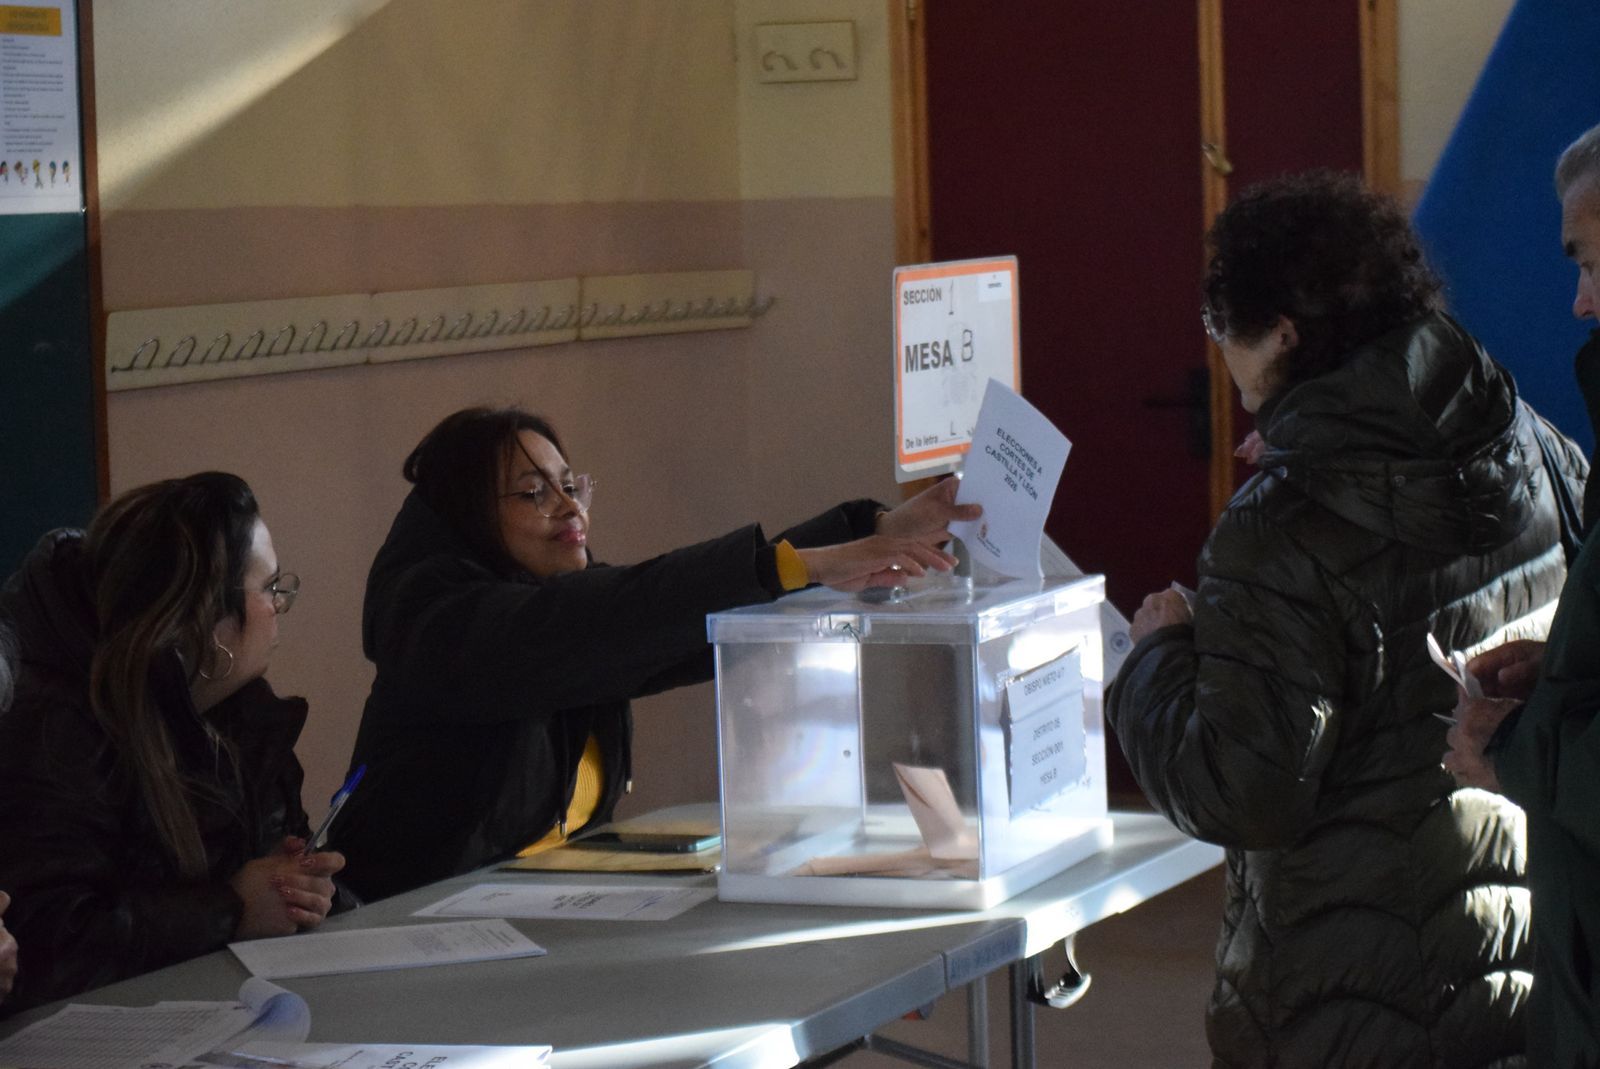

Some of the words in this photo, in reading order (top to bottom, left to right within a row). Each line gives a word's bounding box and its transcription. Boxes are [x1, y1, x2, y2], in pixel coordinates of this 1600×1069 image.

[903, 284, 942, 305] SECCIÓN
[905, 339, 954, 373] MESA
[905, 438, 914, 449] De
[915, 437, 922, 447] la
[923, 435, 938, 446] letra
[996, 427, 1038, 470] ELECCIONES
[1037, 466, 1042, 475] A
[985, 445, 1017, 477] CASTILLA
[1000, 442, 1026, 472] CORTES
[1025, 467, 1035, 481] DE
